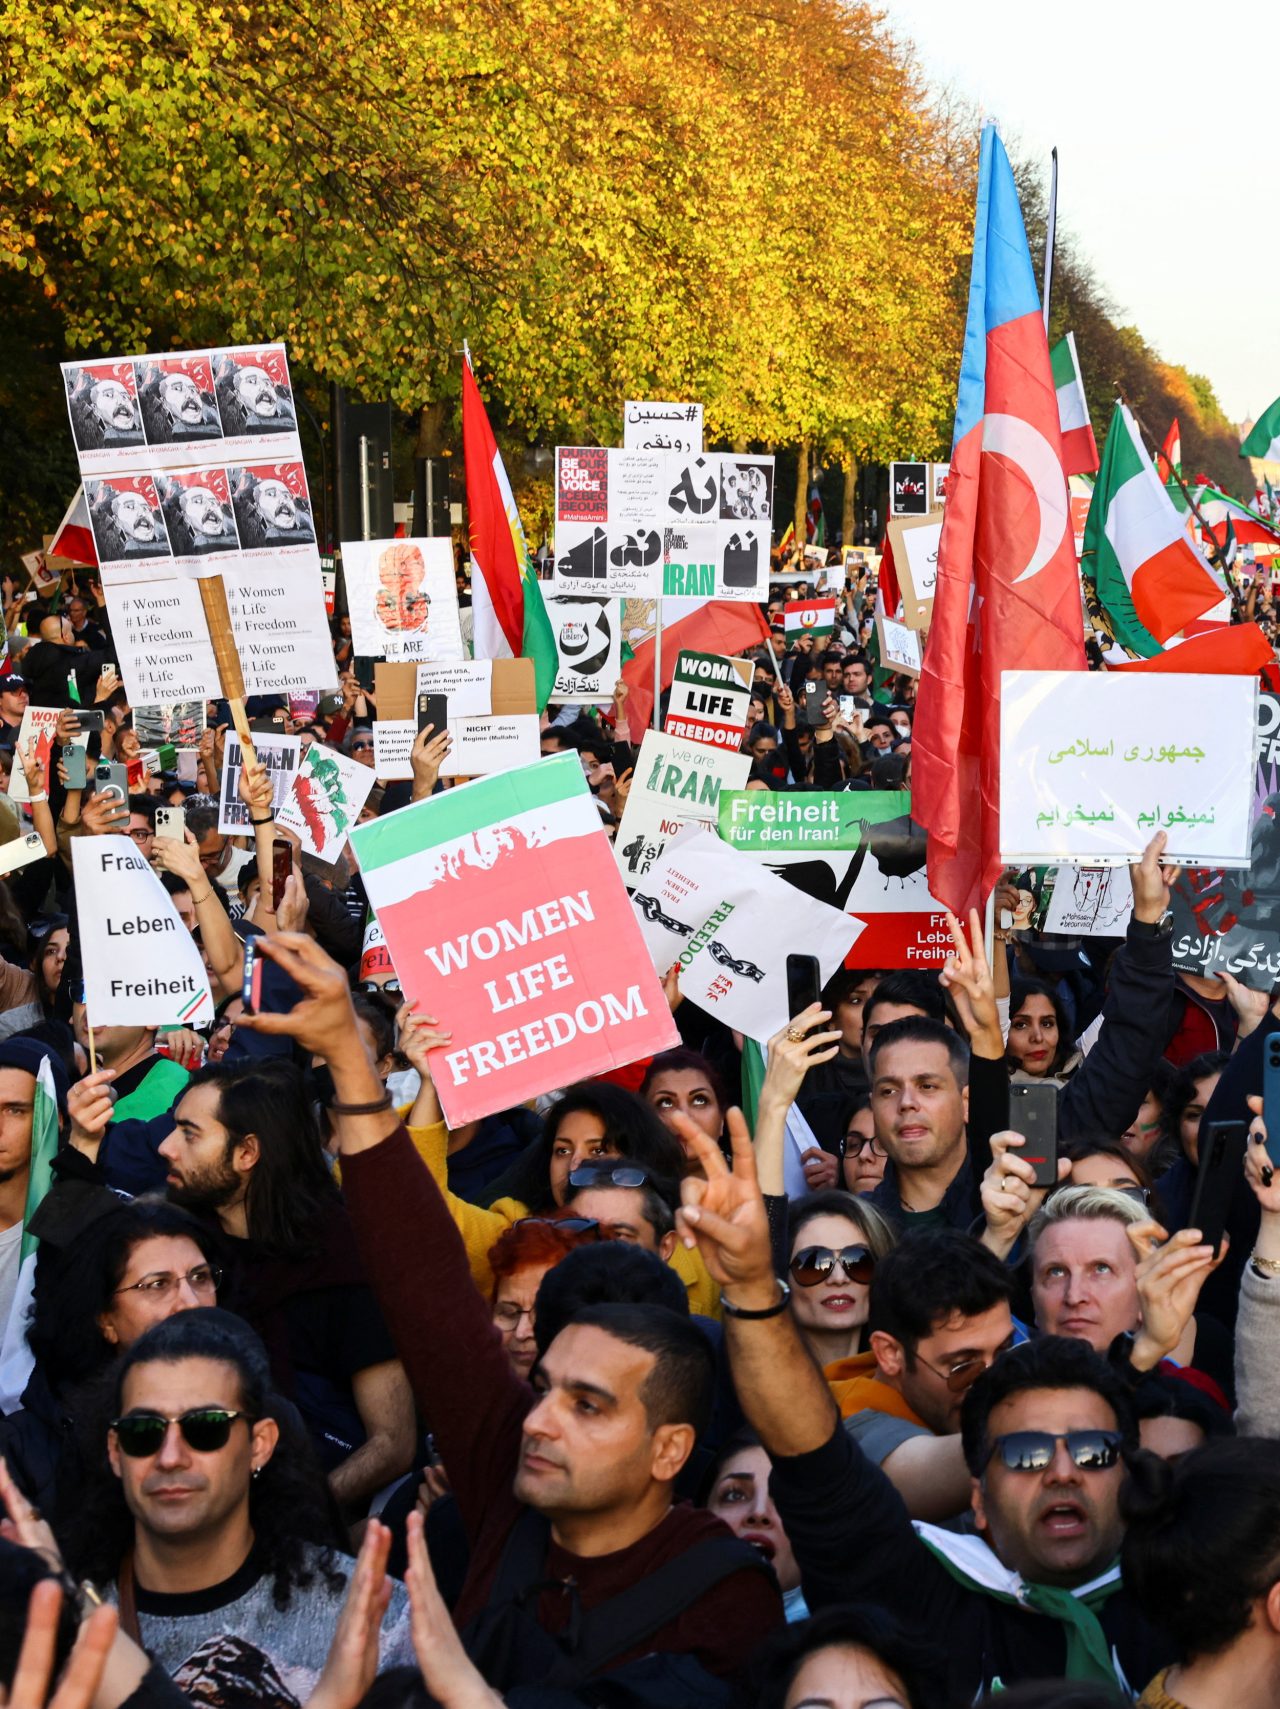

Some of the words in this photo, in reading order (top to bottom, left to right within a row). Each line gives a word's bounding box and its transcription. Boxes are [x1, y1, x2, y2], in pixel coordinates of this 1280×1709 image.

[561, 458, 579, 468] BE
[561, 469, 588, 480] OUR
[561, 480, 600, 491] VOICE
[663, 564, 715, 596] IRAN
[239, 587, 285, 598] Women
[133, 597, 180, 610] Women
[242, 603, 266, 615] Life
[136, 614, 161, 627] Life
[245, 618, 297, 631] Freedom
[140, 629, 193, 643] Freedom
[249, 642, 295, 655] Women
[382, 641, 399, 655] WE
[403, 641, 424, 654] ARE
[145, 653, 193, 666] Women
[252, 660, 276, 671] Life
[149, 670, 174, 682] Life
[255, 674, 307, 687] Freedom
[442, 677, 462, 685] Angst
[153, 684, 206, 698] Freedom
[686, 691, 734, 717] LIFE
[489, 734, 520, 742] (Mullahs)
[666, 721, 742, 747] FREEDOM
[229, 744, 295, 771] WMEN
[1048, 738, 1114, 764] اسلامی
[1124, 743, 1206, 763] جمهوری
[693, 755, 715, 768] are
[731, 799, 840, 823] Freiheit
[729, 826, 753, 841] für
[760, 826, 793, 841] den
[799, 826, 840, 841] Iran!
[106, 914, 176, 936] Leben
[424, 890, 595, 976] WOMEN
[674, 900, 736, 973] FREEDO
[917, 931, 955, 944] Lebe
[110, 975, 196, 997] Freiheit
[483, 954, 574, 1014] LIFE
[445, 985, 649, 1086] FREEDOM
